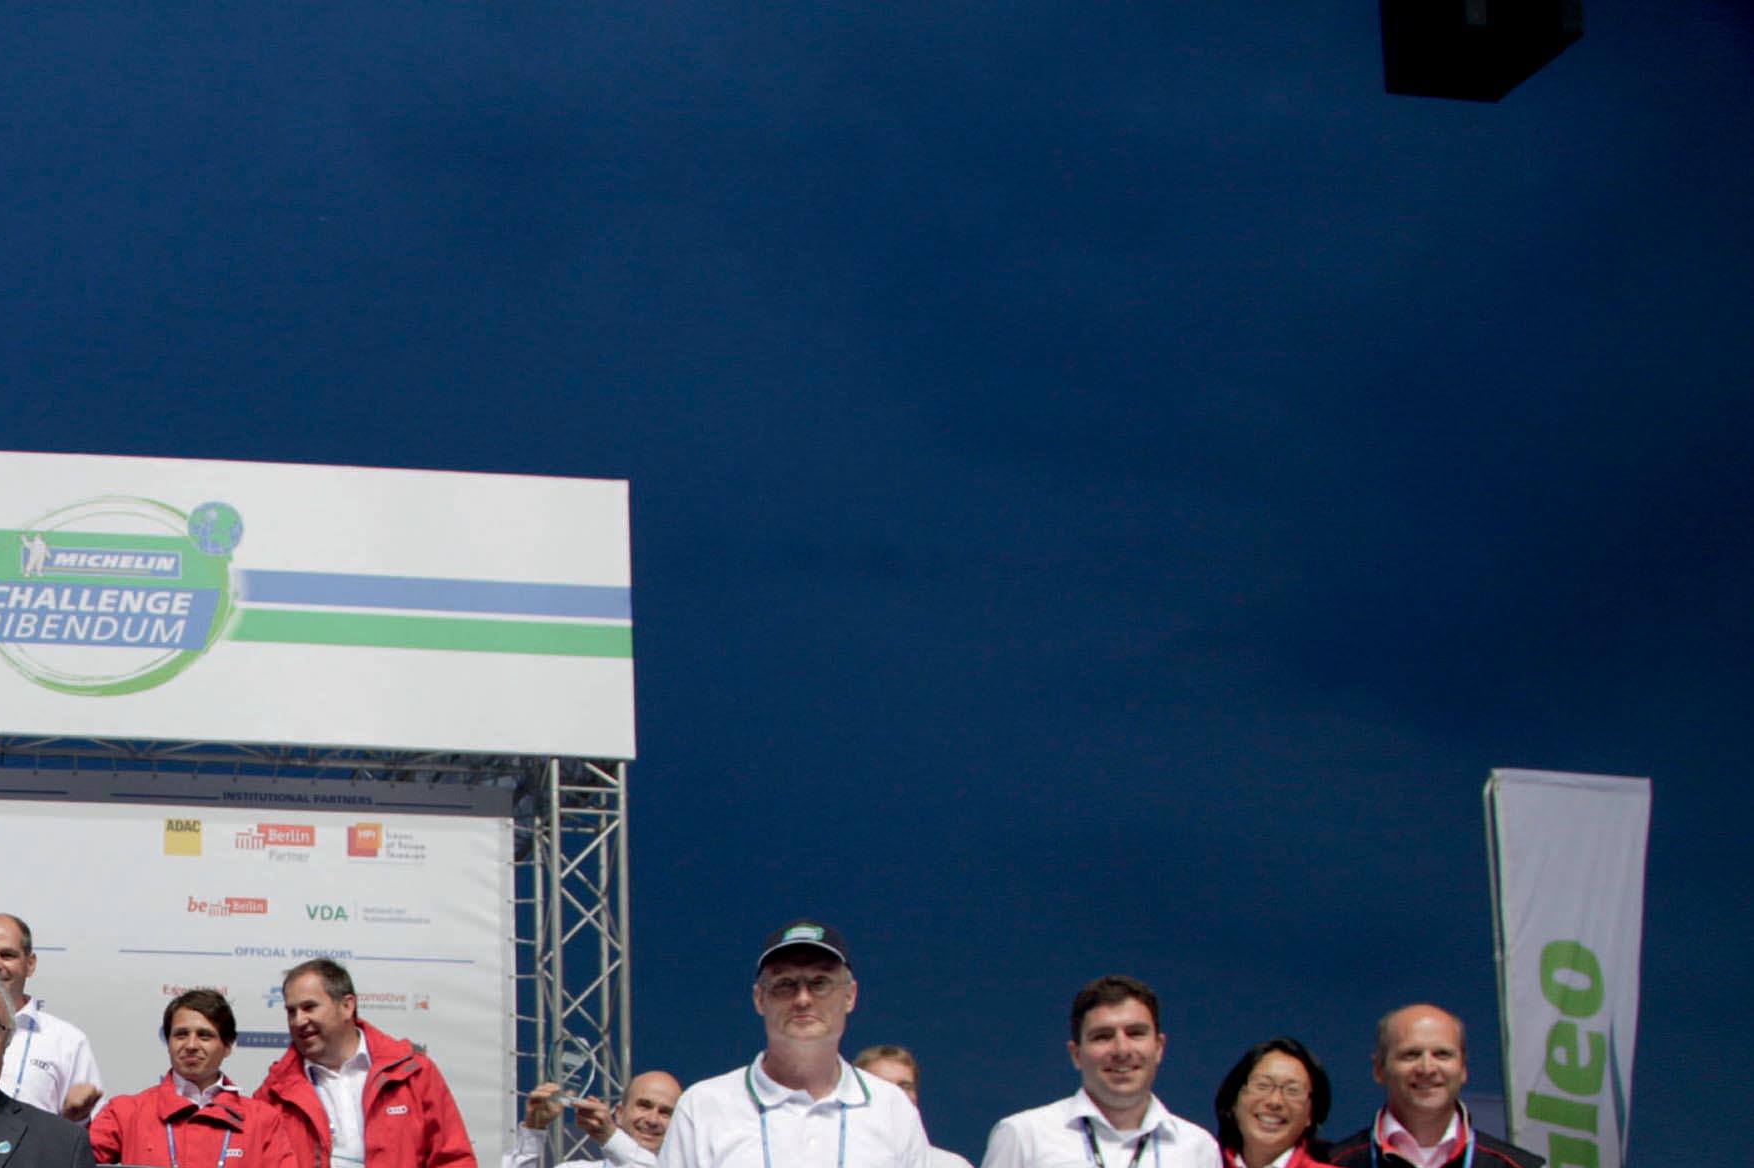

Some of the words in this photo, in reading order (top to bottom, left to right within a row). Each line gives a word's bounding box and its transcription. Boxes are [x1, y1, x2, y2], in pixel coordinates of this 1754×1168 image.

[53, 551, 176, 572] MICHELIN
[222, 791, 309, 804] INSTITUTIONAL
[313, 793, 374, 806] PARTNERS
[166, 819, 201, 833] ADAC
[268, 828, 311, 844] Berlin
[306, 904, 349, 921] VDA
[234, 946, 286, 958] OFFICIAL
